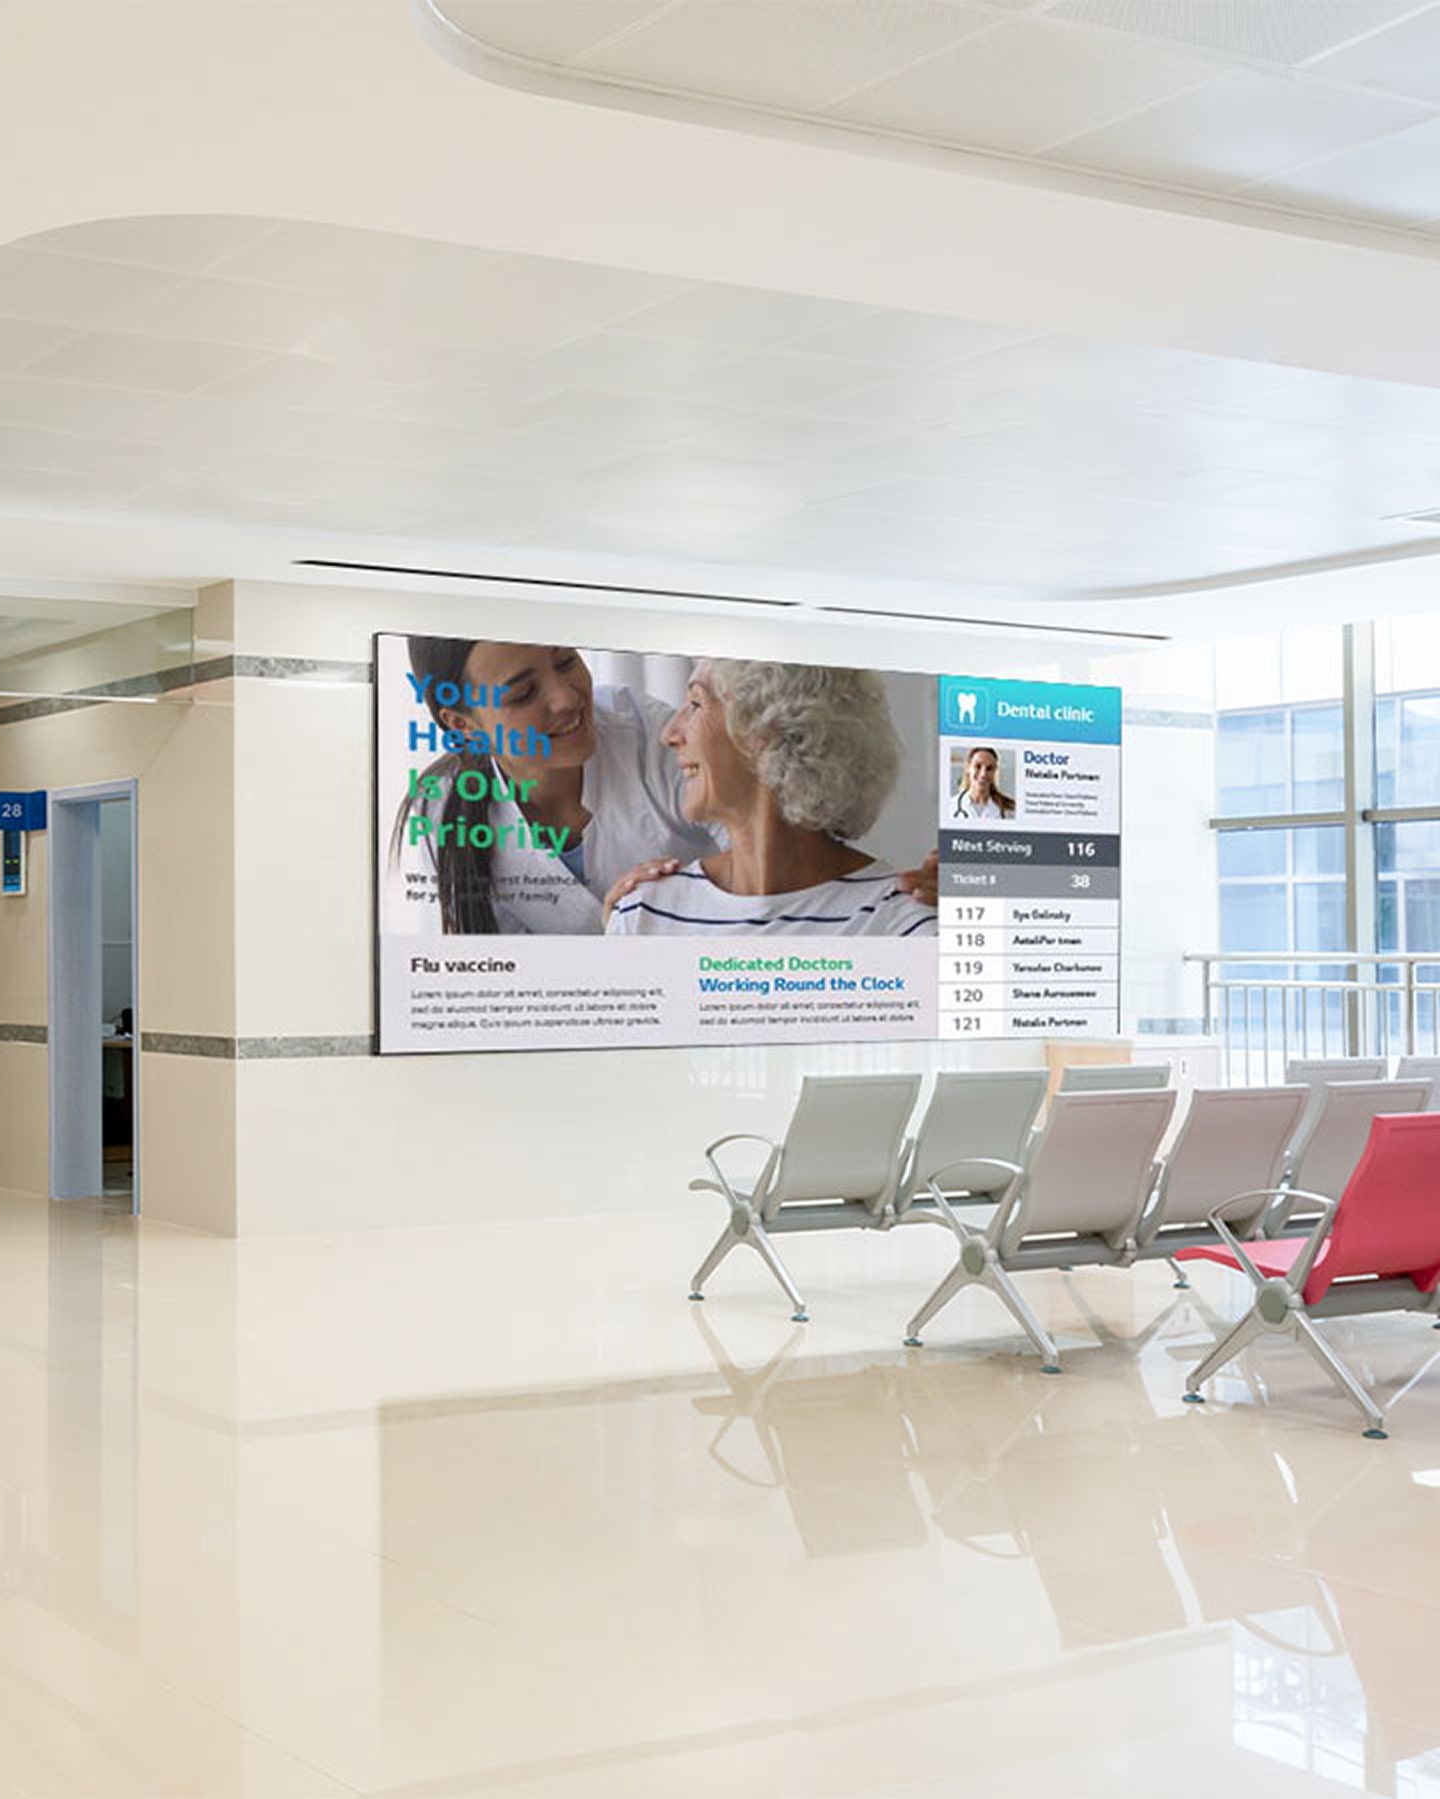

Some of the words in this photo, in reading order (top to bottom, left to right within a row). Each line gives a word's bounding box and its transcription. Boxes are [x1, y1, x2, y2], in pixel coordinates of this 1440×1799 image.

[406, 672, 512, 709] Your
[997, 701, 1051, 720] Dental
[1054, 705, 1095, 723] clinic
[409, 720, 552, 759] Health
[1024, 750, 1069, 765] Doctor
[409, 768, 443, 800] Is
[456, 770, 538, 803] Our
[1, 803, 22, 817] 28
[409, 815, 570, 859] Priority
[952, 839, 983, 852] Next
[986, 840, 1032, 857] Serving
[1067, 842, 1096, 857] 116
[406, 874, 427, 884] We
[952, 874, 986, 886] Ticket
[1071, 874, 1091, 888] 38
[956, 907, 985, 920] 117
[956, 933, 985, 947] 118
[410, 957, 440, 973] Flu
[445, 957, 516, 973] vaccine
[699, 956, 784, 971] Dedicated
[789, 957, 853, 971] Doctors
[954, 961, 983, 975] 119
[699, 978, 770, 995] Working
[774, 977, 826, 991] Round
[831, 977, 856, 991] the
[861, 976, 905, 991] Clock
[954, 988, 983, 1003] 120
[954, 1017, 981, 1031] 121
